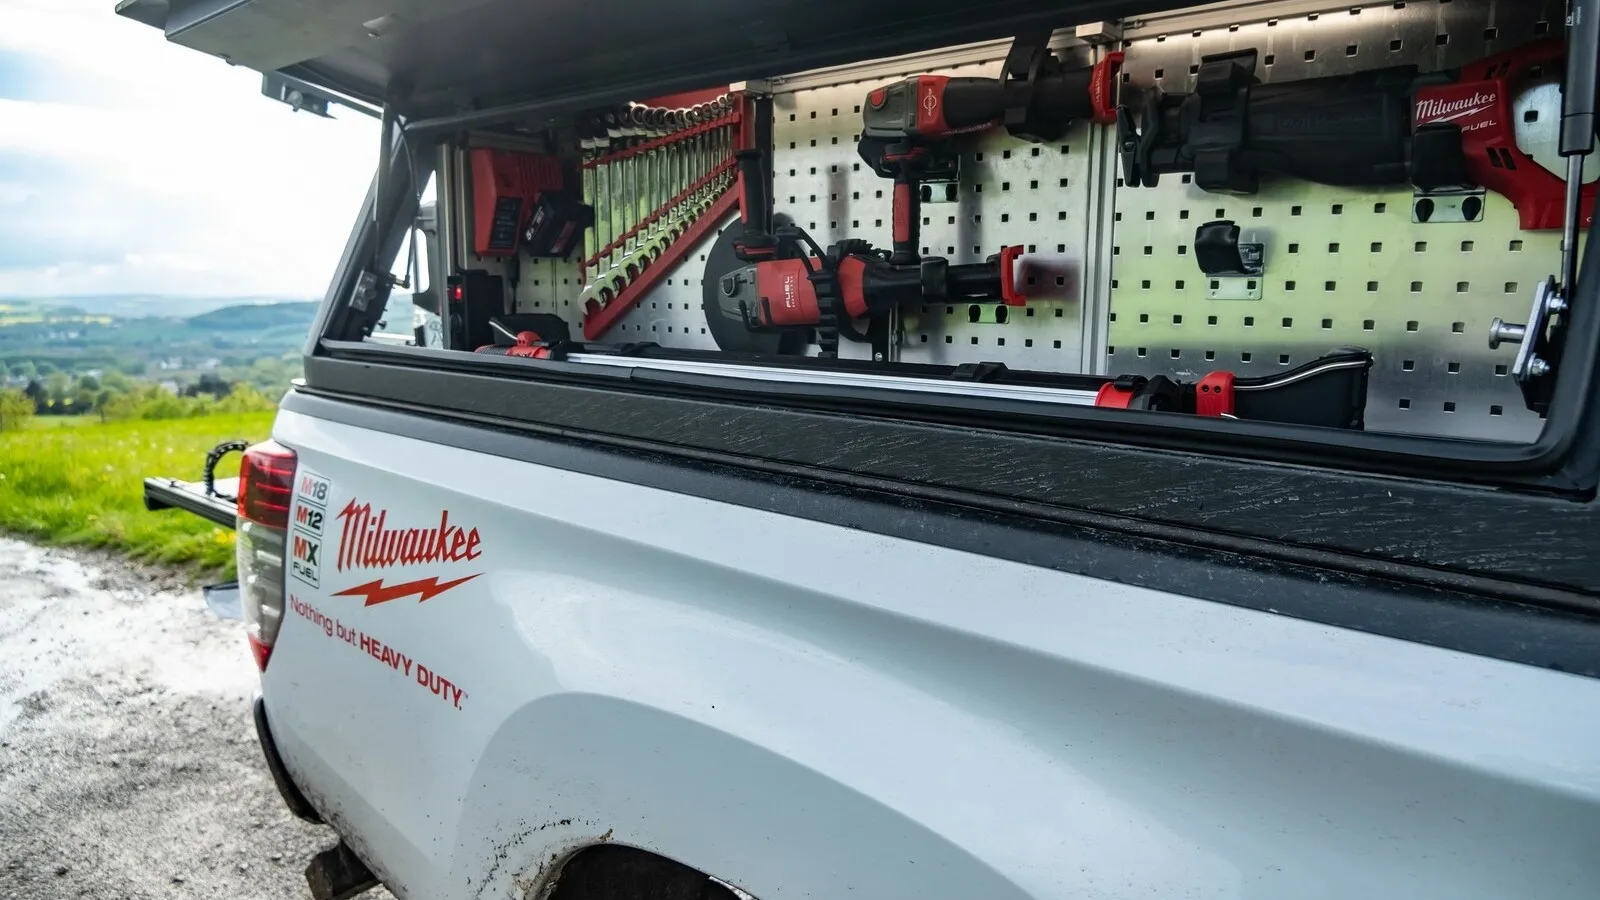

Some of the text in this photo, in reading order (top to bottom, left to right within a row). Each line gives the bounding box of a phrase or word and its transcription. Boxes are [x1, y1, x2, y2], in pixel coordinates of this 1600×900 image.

[1416, 92, 1496, 120] Milwaukee
[1461, 120, 1497, 133] FUEL
[301, 477, 327, 500] M18
[296, 505, 323, 530] M12
[335, 497, 482, 573] Milwaukee
[293, 535, 318, 566] MX
[293, 562, 317, 581] FUEL
[290, 594, 333, 637] Nothing
[336, 618, 357, 646] but
[360, 632, 413, 676] HEAVY
